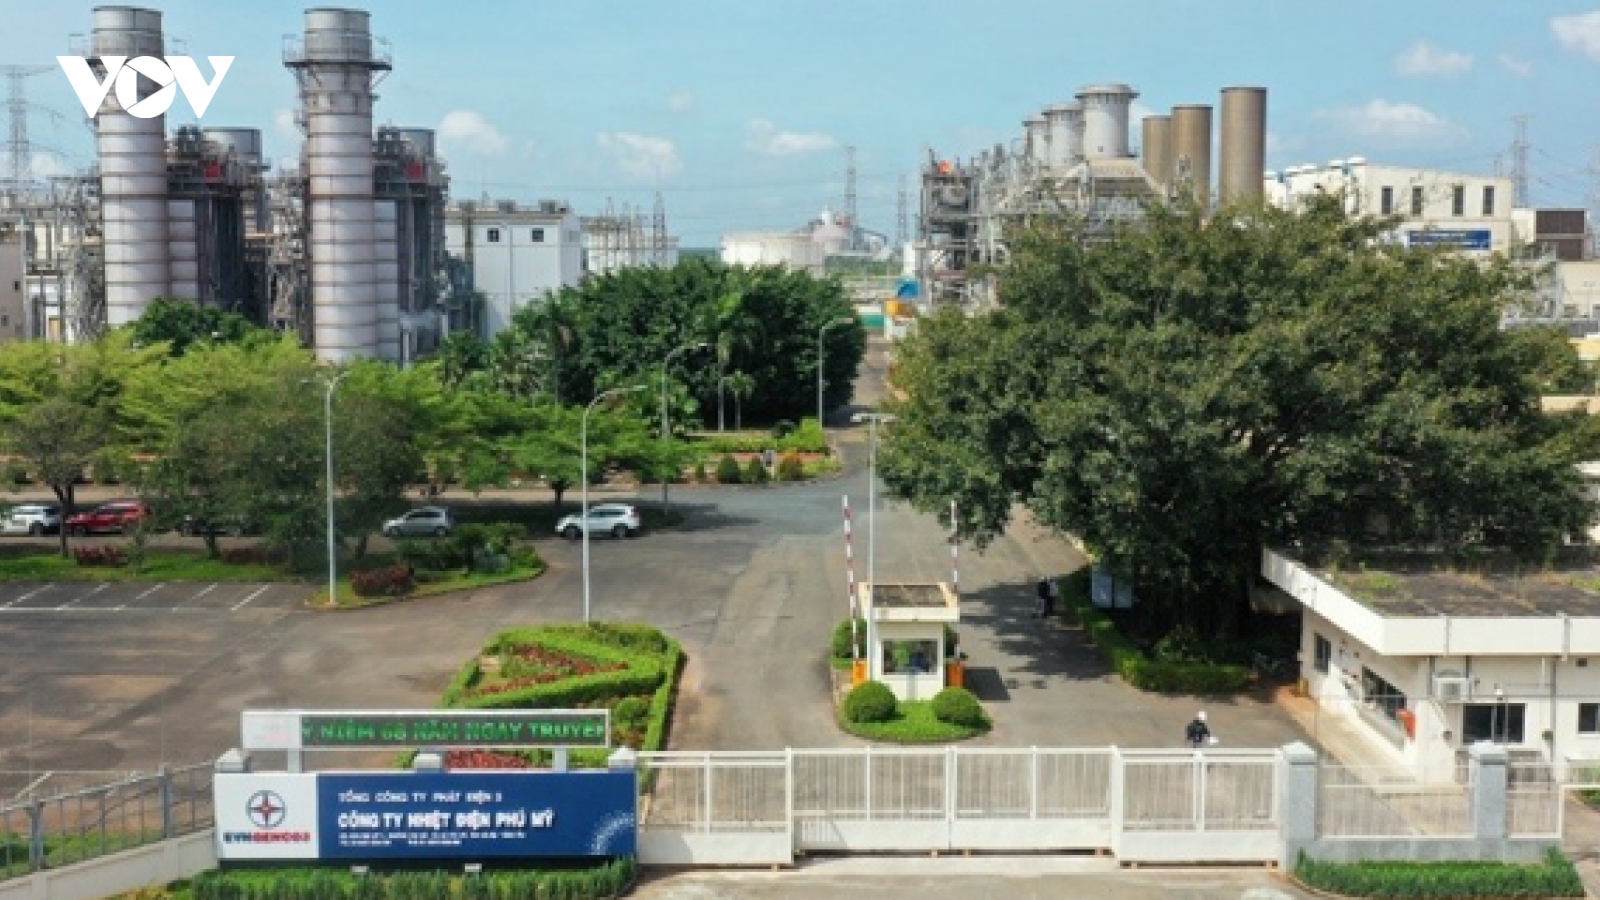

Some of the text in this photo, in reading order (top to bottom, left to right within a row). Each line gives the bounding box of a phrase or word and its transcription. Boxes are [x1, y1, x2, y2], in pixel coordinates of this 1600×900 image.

[411, 792, 427, 802] TY
[337, 809, 379, 829] CÔNG
[382, 812, 404, 829] TY
[407, 809, 452, 831] NHIỆT
[455, 809, 491, 831] ĐIỆN
[495, 807, 526, 829] PHÚ
